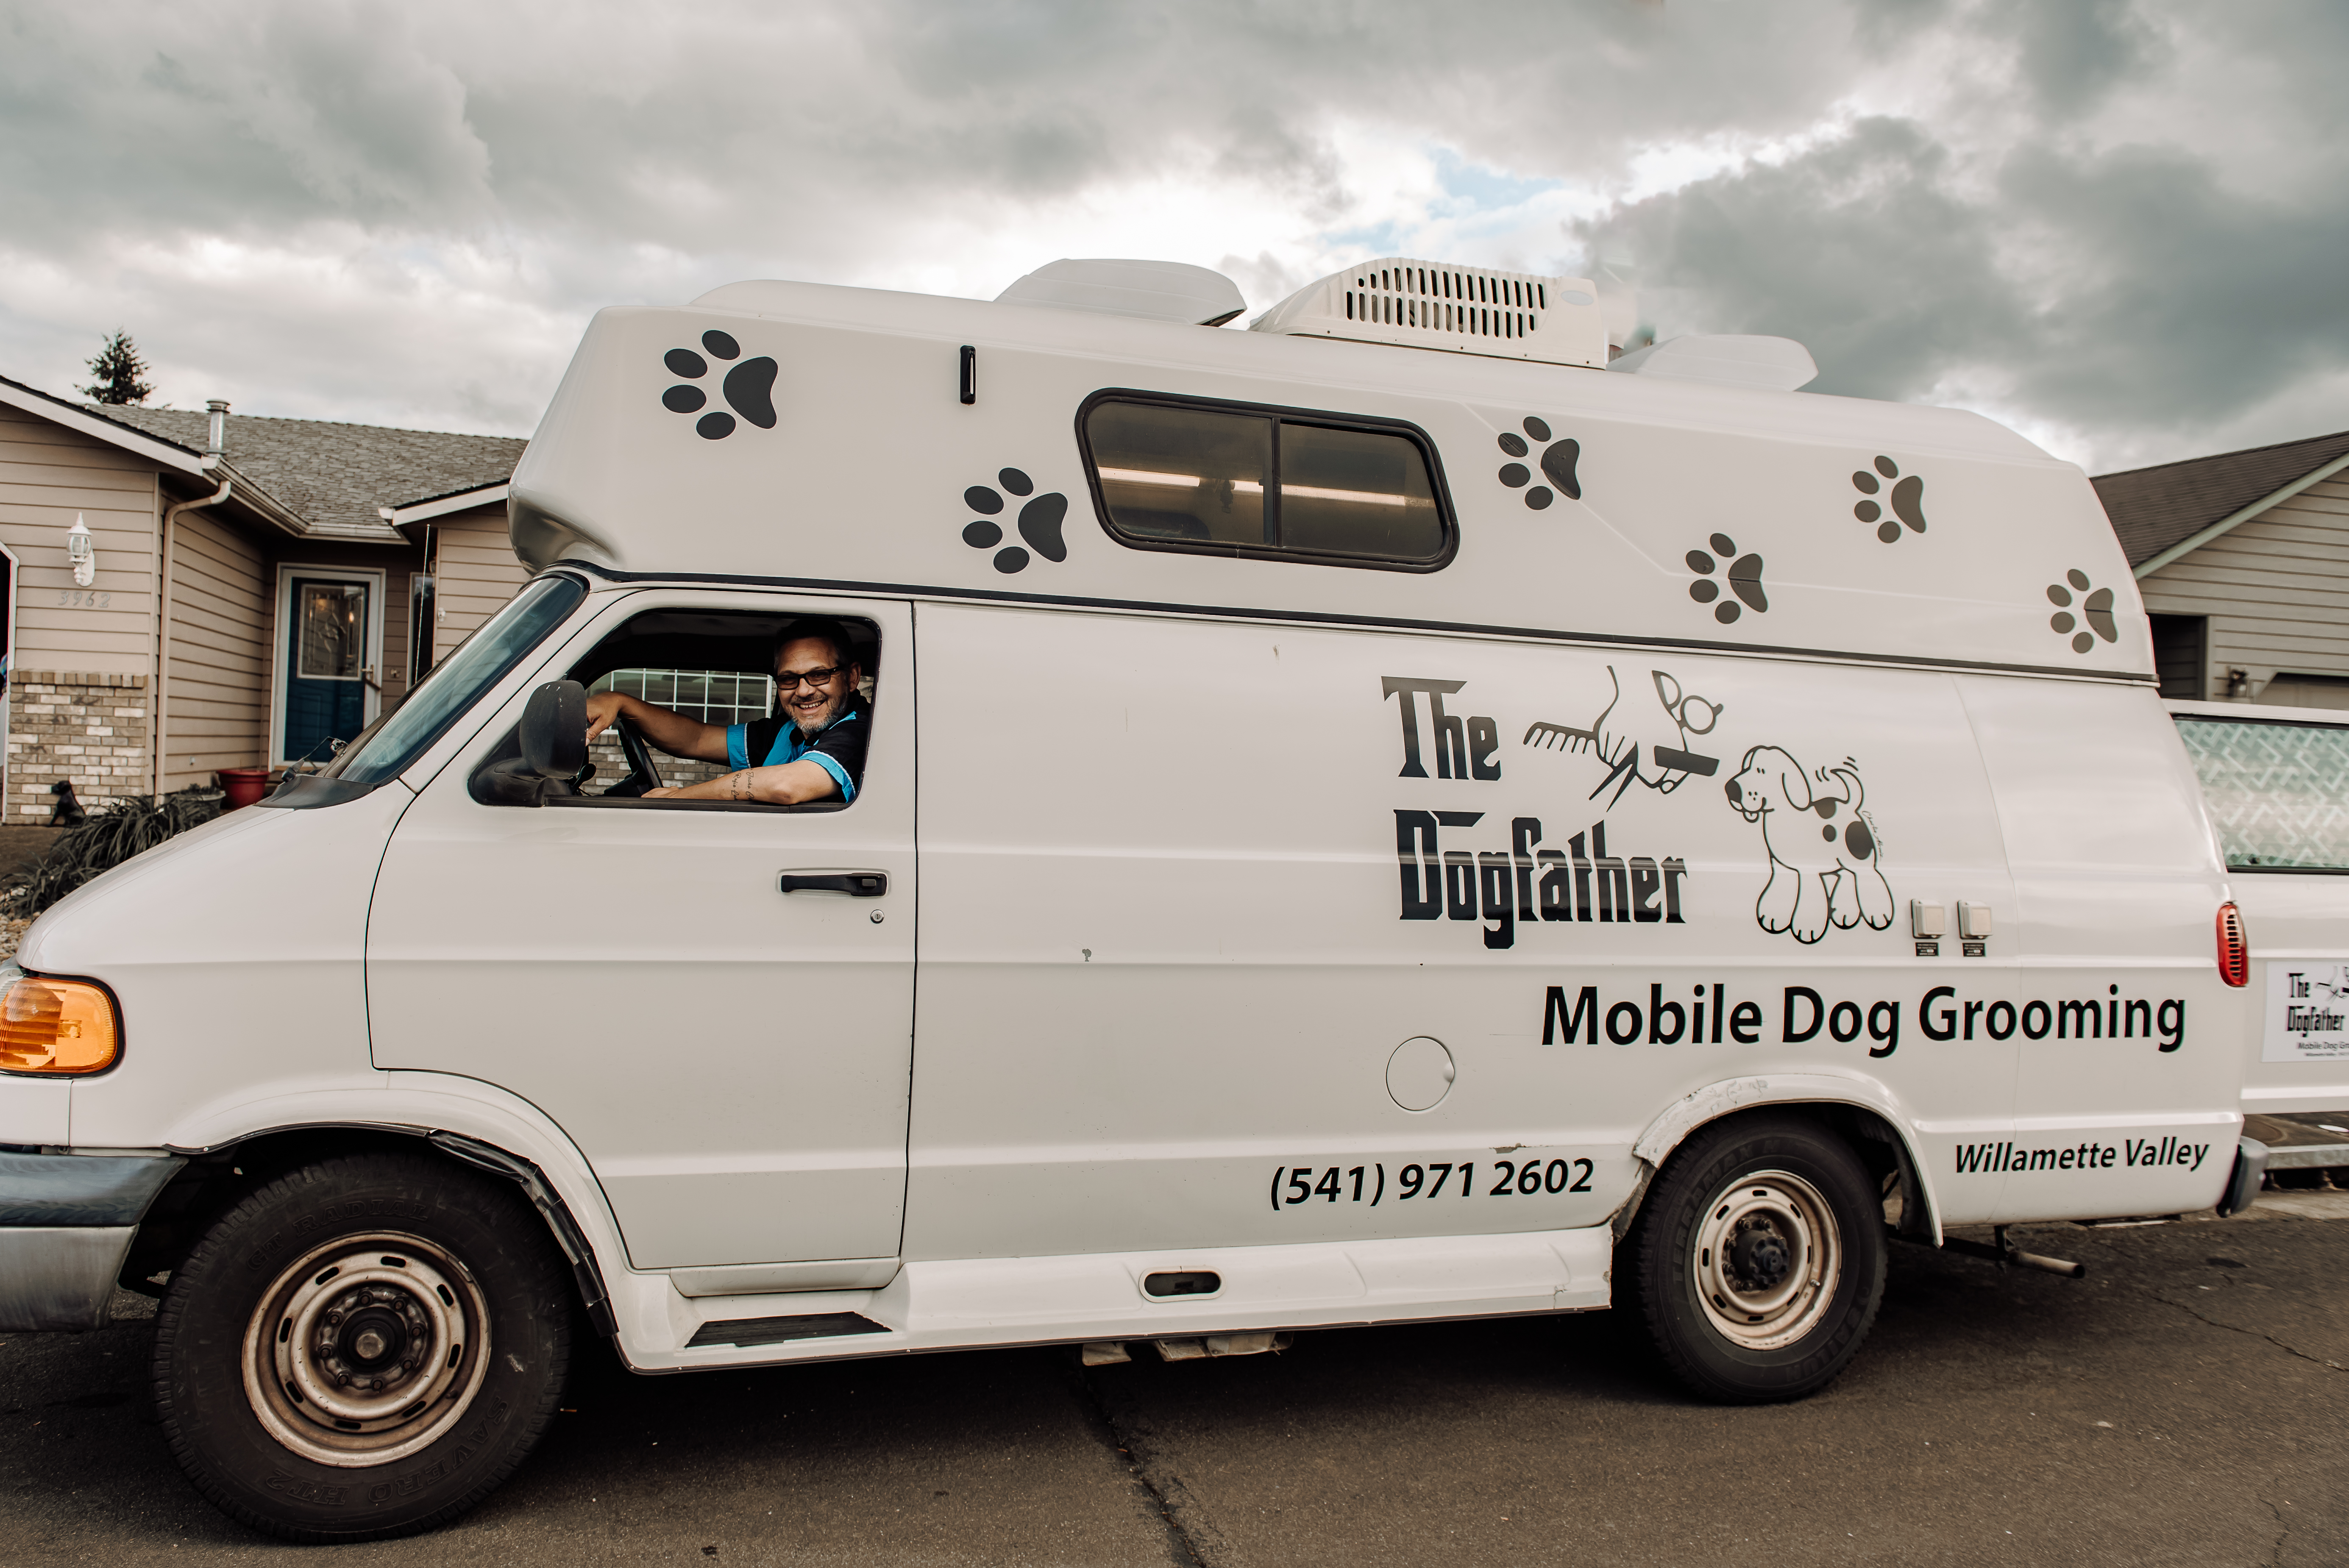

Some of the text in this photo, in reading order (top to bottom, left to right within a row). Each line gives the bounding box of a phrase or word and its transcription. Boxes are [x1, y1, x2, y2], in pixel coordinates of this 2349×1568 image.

[58, 591, 110, 608] 3962
[1381, 676, 1501, 781] The
[1393, 809, 1687, 949] Dogfather
[2288, 973, 2310, 998] The
[1542, 983, 2185, 1059] Mobile Dog Grooming
[2287, 1006, 2345, 1037] Dogfather
[1271, 1158, 1593, 1211] (541) 971 2602
[1956, 1136, 2210, 1173] Willamette Valley
[246, 1198, 430, 1272] GT RADIAL
[368, 1395, 508, 1504] SAVERO
